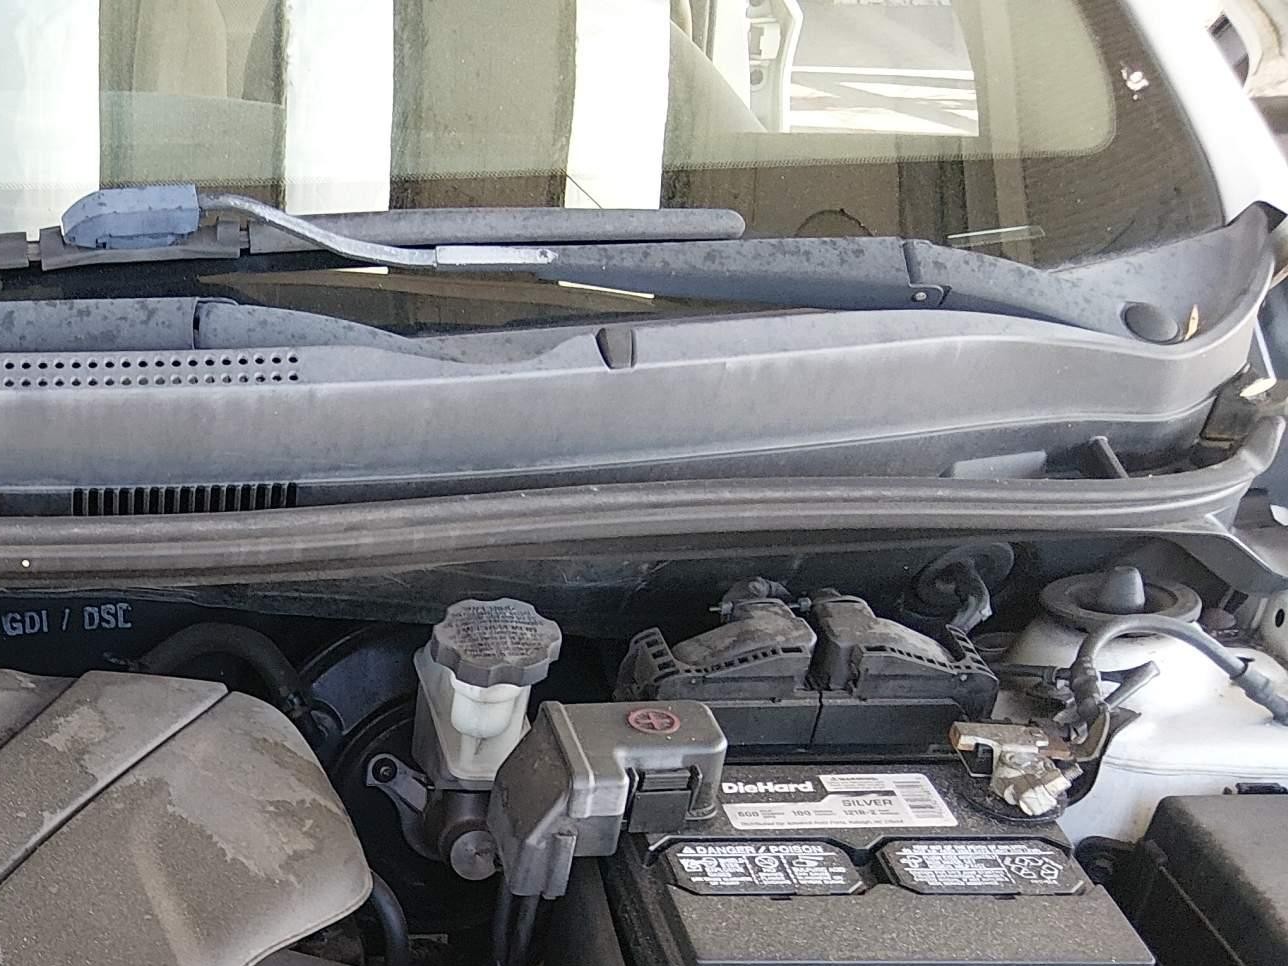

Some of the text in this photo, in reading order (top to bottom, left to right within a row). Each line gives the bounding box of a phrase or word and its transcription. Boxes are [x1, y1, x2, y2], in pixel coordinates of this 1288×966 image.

[1, 609, 49, 636] GDI
[722, 781, 815, 794] DieHard
[695, 846, 757, 855] DANGER
[769, 845, 825, 854] POISON
